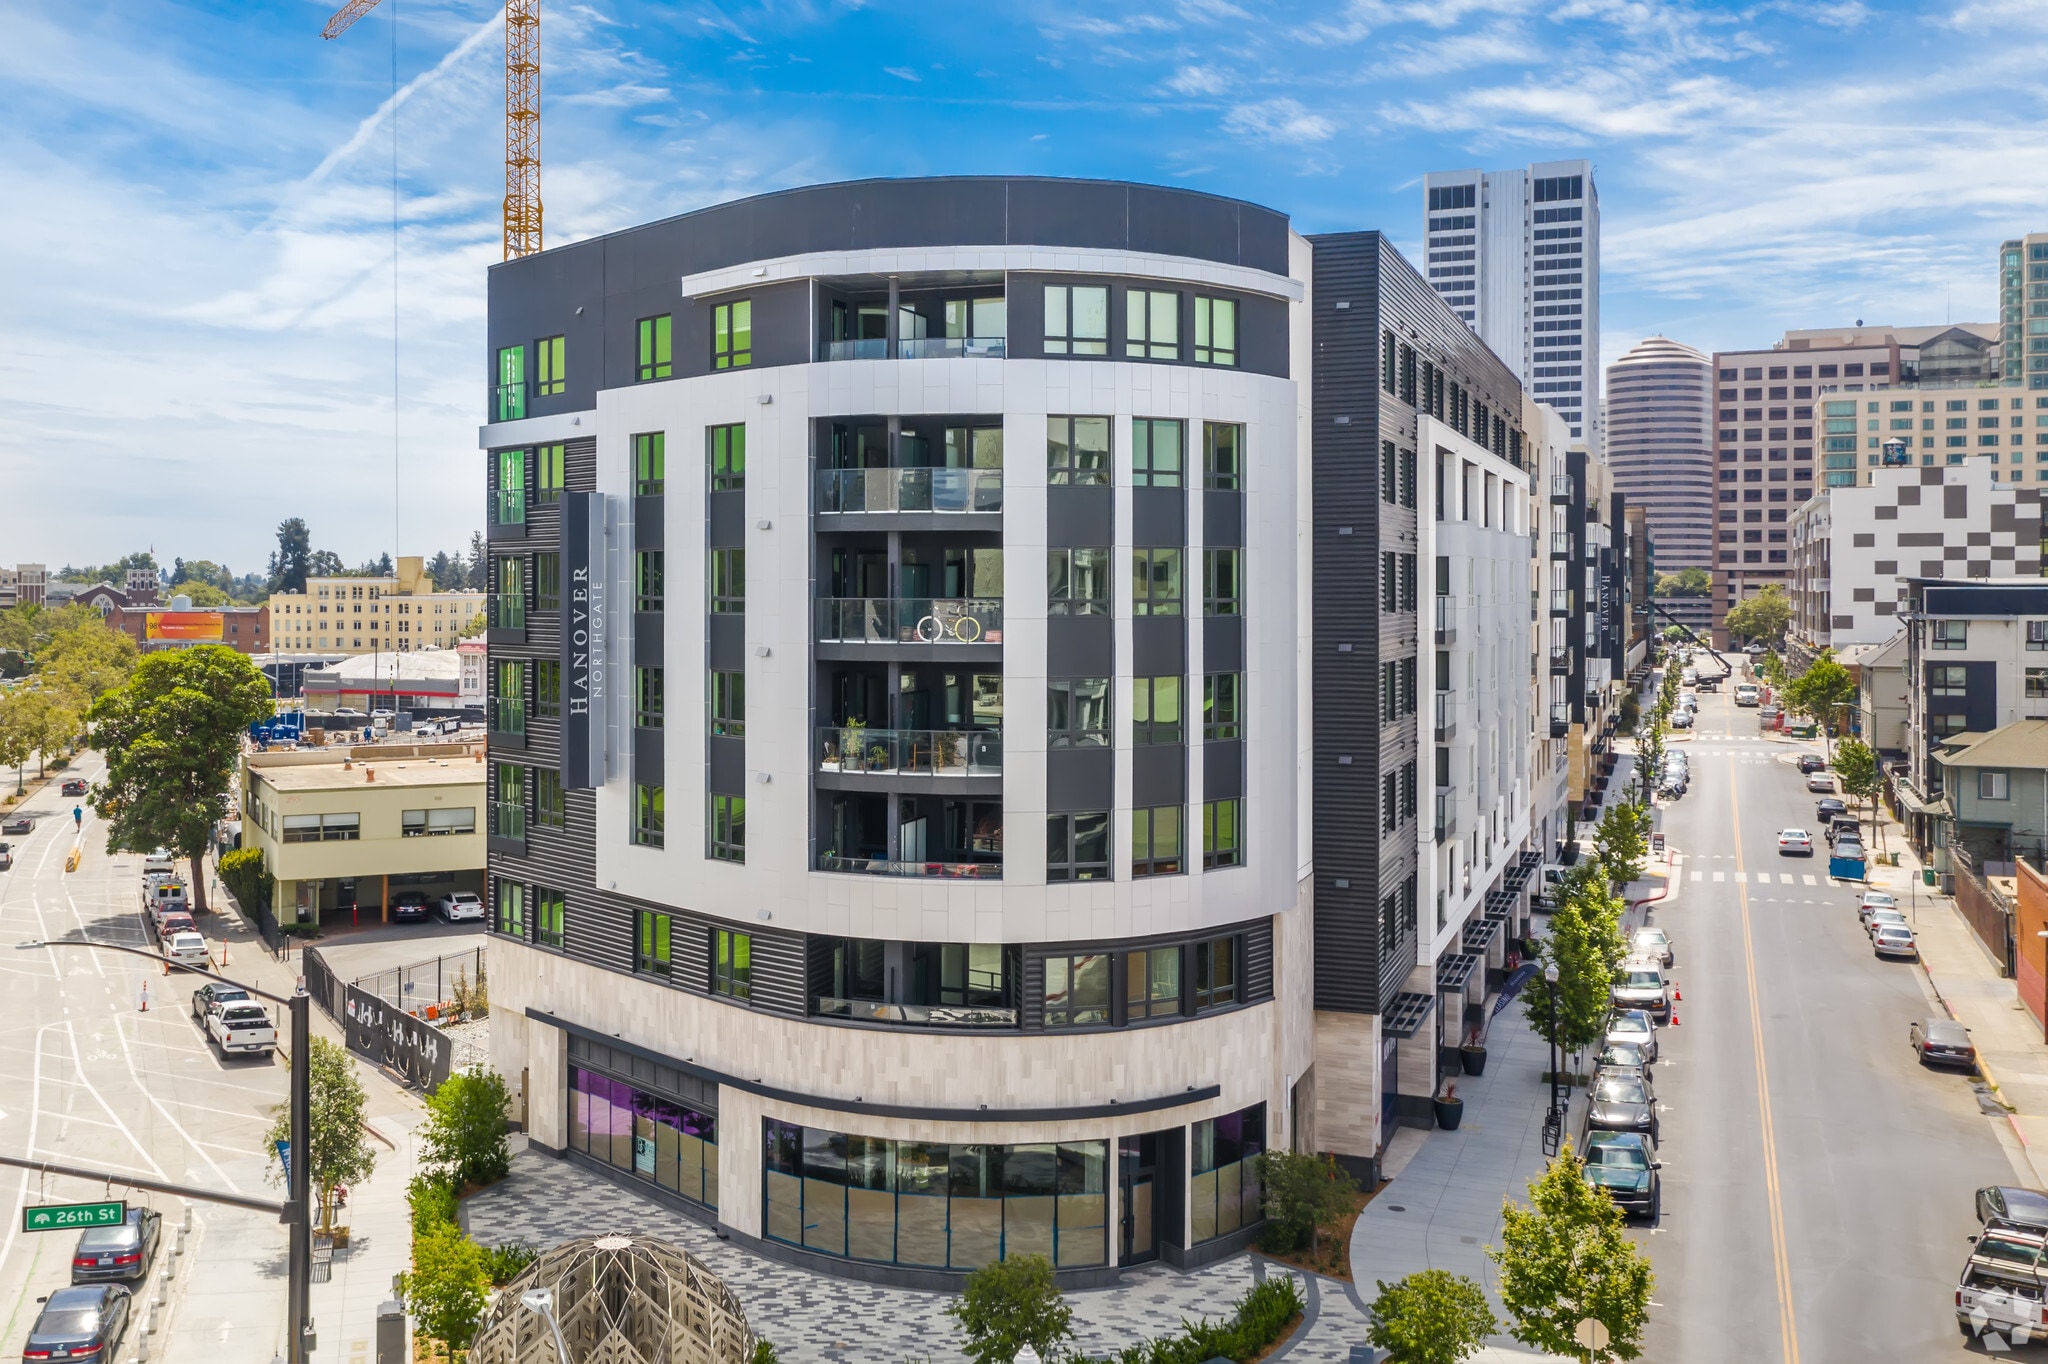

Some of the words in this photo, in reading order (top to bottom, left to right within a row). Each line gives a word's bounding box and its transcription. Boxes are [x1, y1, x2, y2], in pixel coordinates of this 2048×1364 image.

[570, 566, 588, 715] HANOVER
[592, 582, 603, 698] NORTHGATE
[1601, 575, 1611, 631] HANOVER
[56, 1210, 93, 1224] 26th
[98, 1208, 116, 1221] St
